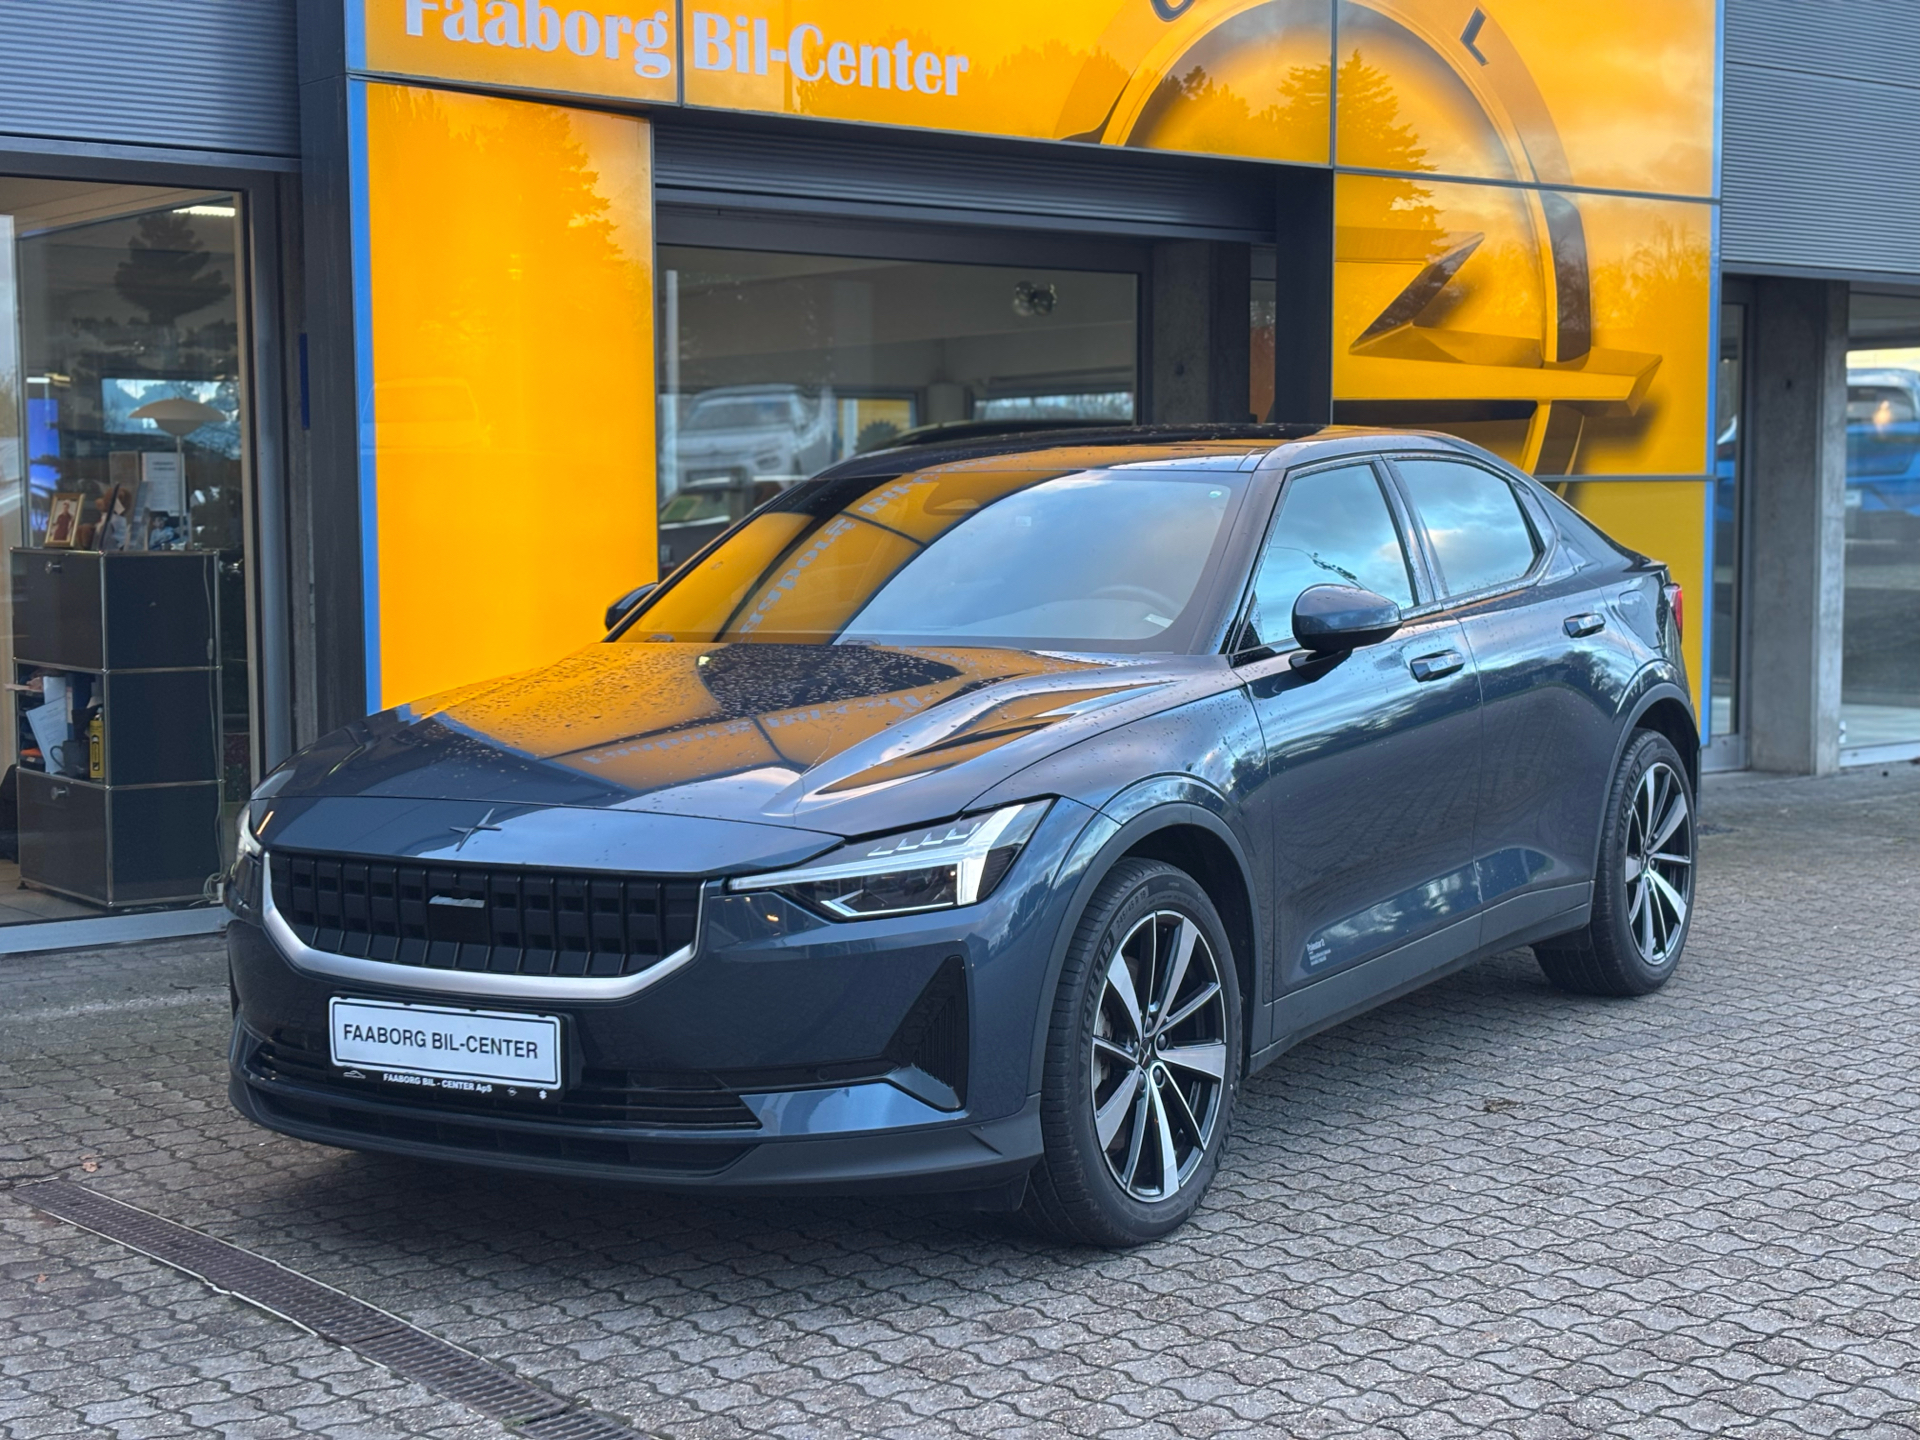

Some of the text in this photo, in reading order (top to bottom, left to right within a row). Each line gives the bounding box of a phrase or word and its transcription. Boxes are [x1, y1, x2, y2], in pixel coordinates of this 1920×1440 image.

[404, 0, 970, 96] Faaborg Bil-Center
[1079, 936, 1112, 1065] MICHELIN
[343, 1023, 539, 1060] FAABORG BIL-CENTER
[383, 1073, 421, 1085] FAABORG
[422, 1078, 436, 1087] BIL
[442, 1080, 475, 1091] CENTER
[476, 1083, 493, 1094] ApS
